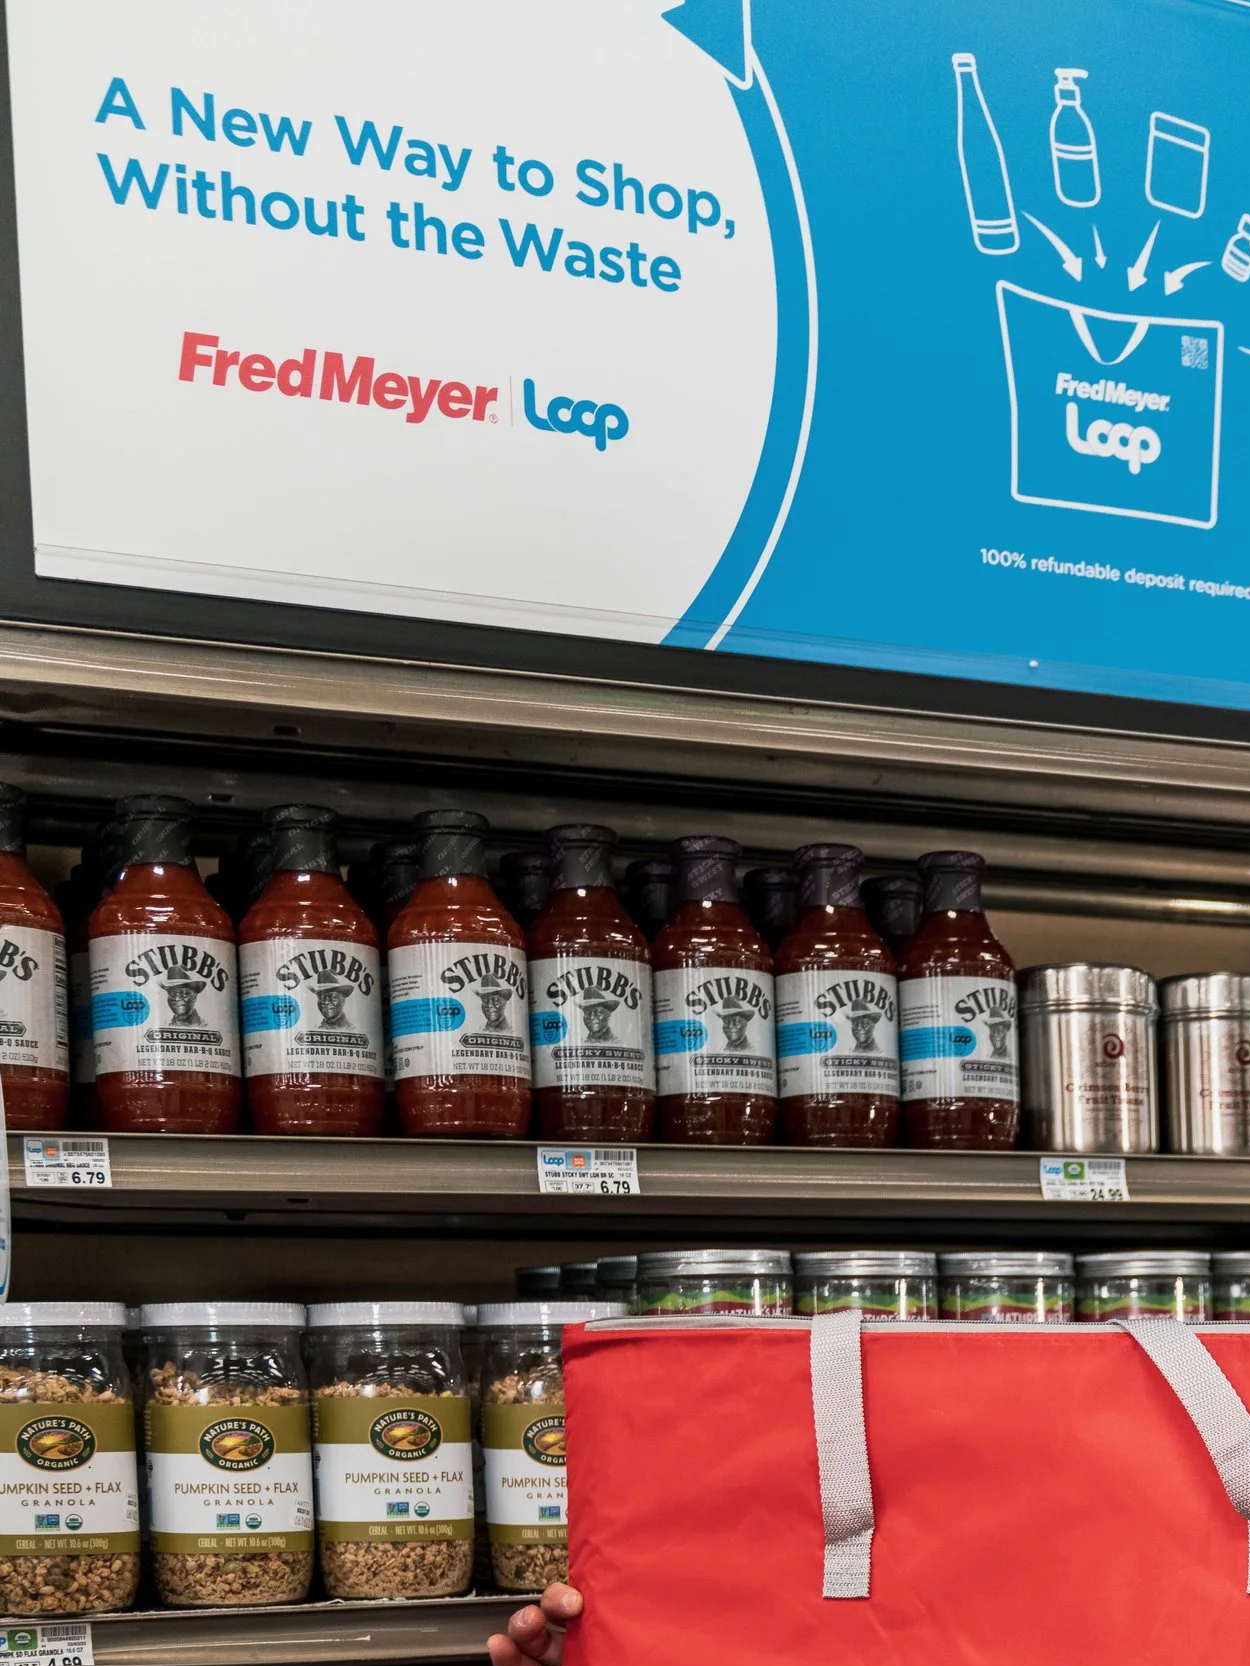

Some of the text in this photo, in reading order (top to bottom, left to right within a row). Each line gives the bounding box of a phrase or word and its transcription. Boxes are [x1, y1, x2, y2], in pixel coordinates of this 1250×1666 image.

[95, 77, 737, 240] A New Way to Shop,
[97, 153, 682, 293] Without the Waste
[523, 377, 630, 451] Loop
[1066, 401, 1161, 475] Loop
[980, 548, 1027, 569] 100%
[1031, 556, 1120, 581] refundable
[1124, 568, 1185, 590] deposit
[125, 944, 229, 992] STUBB'S
[275, 949, 375, 997] STUBB'S
[440, 953, 526, 1001] STUBB'S
[546, 966, 642, 1011] STUBB'S
[684, 976, 773, 1021] STUBB'S
[153, 1031, 219, 1043] ORIGINAL
[302, 1034, 365, 1046] ORIGINAL
[136, 1045, 182, 1056] LEGENDARY
[183, 1046, 213, 1057] BAR-B-Q
[286, 1047, 331, 1057] LEGENDARY
[451, 1049, 495, 1059] LEGENDARY
[543, 1154, 564, 1166] Loop
[72, 1171, 105, 1184] 6.79
[600, 1180, 631, 1194] 6.79
[374, 1412, 438, 1433] NATURE'S PATH
[20, 1419, 92, 1441] NATURE'S PATH
[203, 1420, 271, 1442] NATURE'S PATH
[388, 1448, 427, 1458] ORGANIC
[36, 1458, 79, 1468] ORGANIC
[218, 1459, 259, 1470] ORGANIC
[345, 1471, 464, 1484] PUMPKIN SEED FLAX
[501, 1477, 551, 1488] PUMPKIN
[52, 1482, 83, 1494] SEED
[95, 1481, 122, 1493] FLAX
[174, 1482, 299, 1495] PUMPKIN SEED FLAX
[374, 1487, 442, 1495] GRANOLA
[21, 1499, 96, 1507] GRANOLA
[44, 1538, 57, 1549] NET
